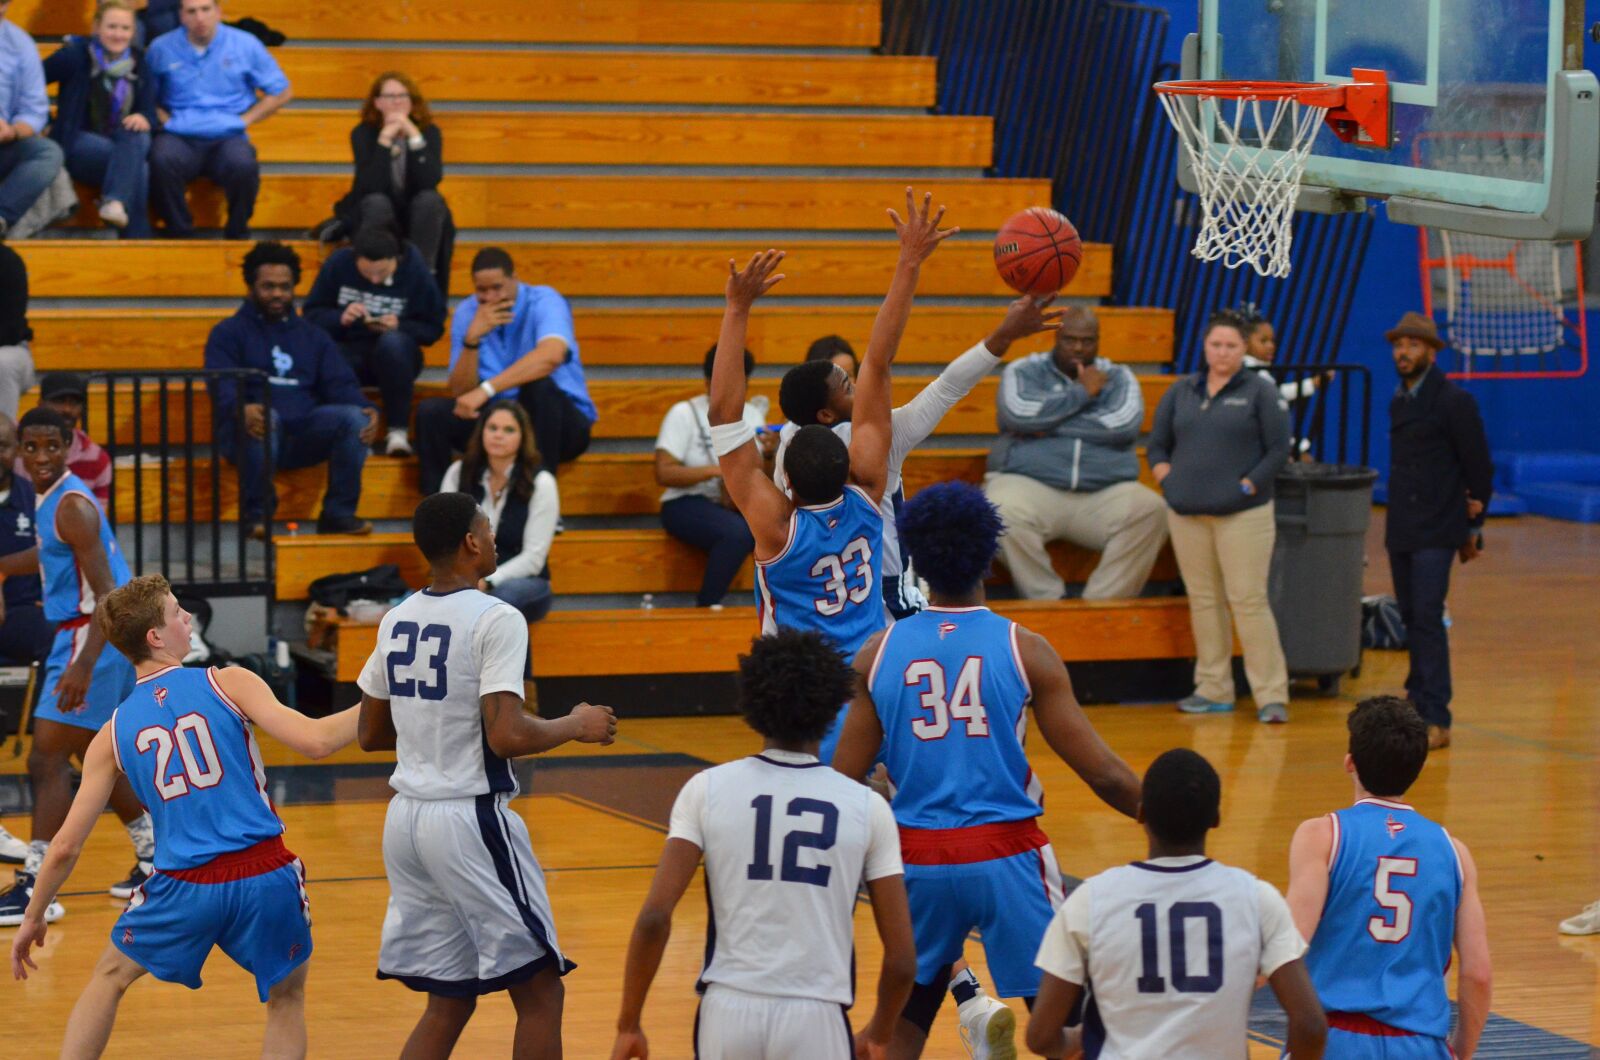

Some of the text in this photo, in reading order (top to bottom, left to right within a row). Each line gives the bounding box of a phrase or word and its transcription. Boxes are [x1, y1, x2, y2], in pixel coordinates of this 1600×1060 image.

[809, 535, 873, 617] 33
[386, 621, 452, 701] 23
[903, 655, 990, 741] 34
[134, 711, 224, 801] 20
[747, 794, 839, 887] 12
[1366, 856, 1418, 944] 5
[1134, 901, 1224, 993] 10
